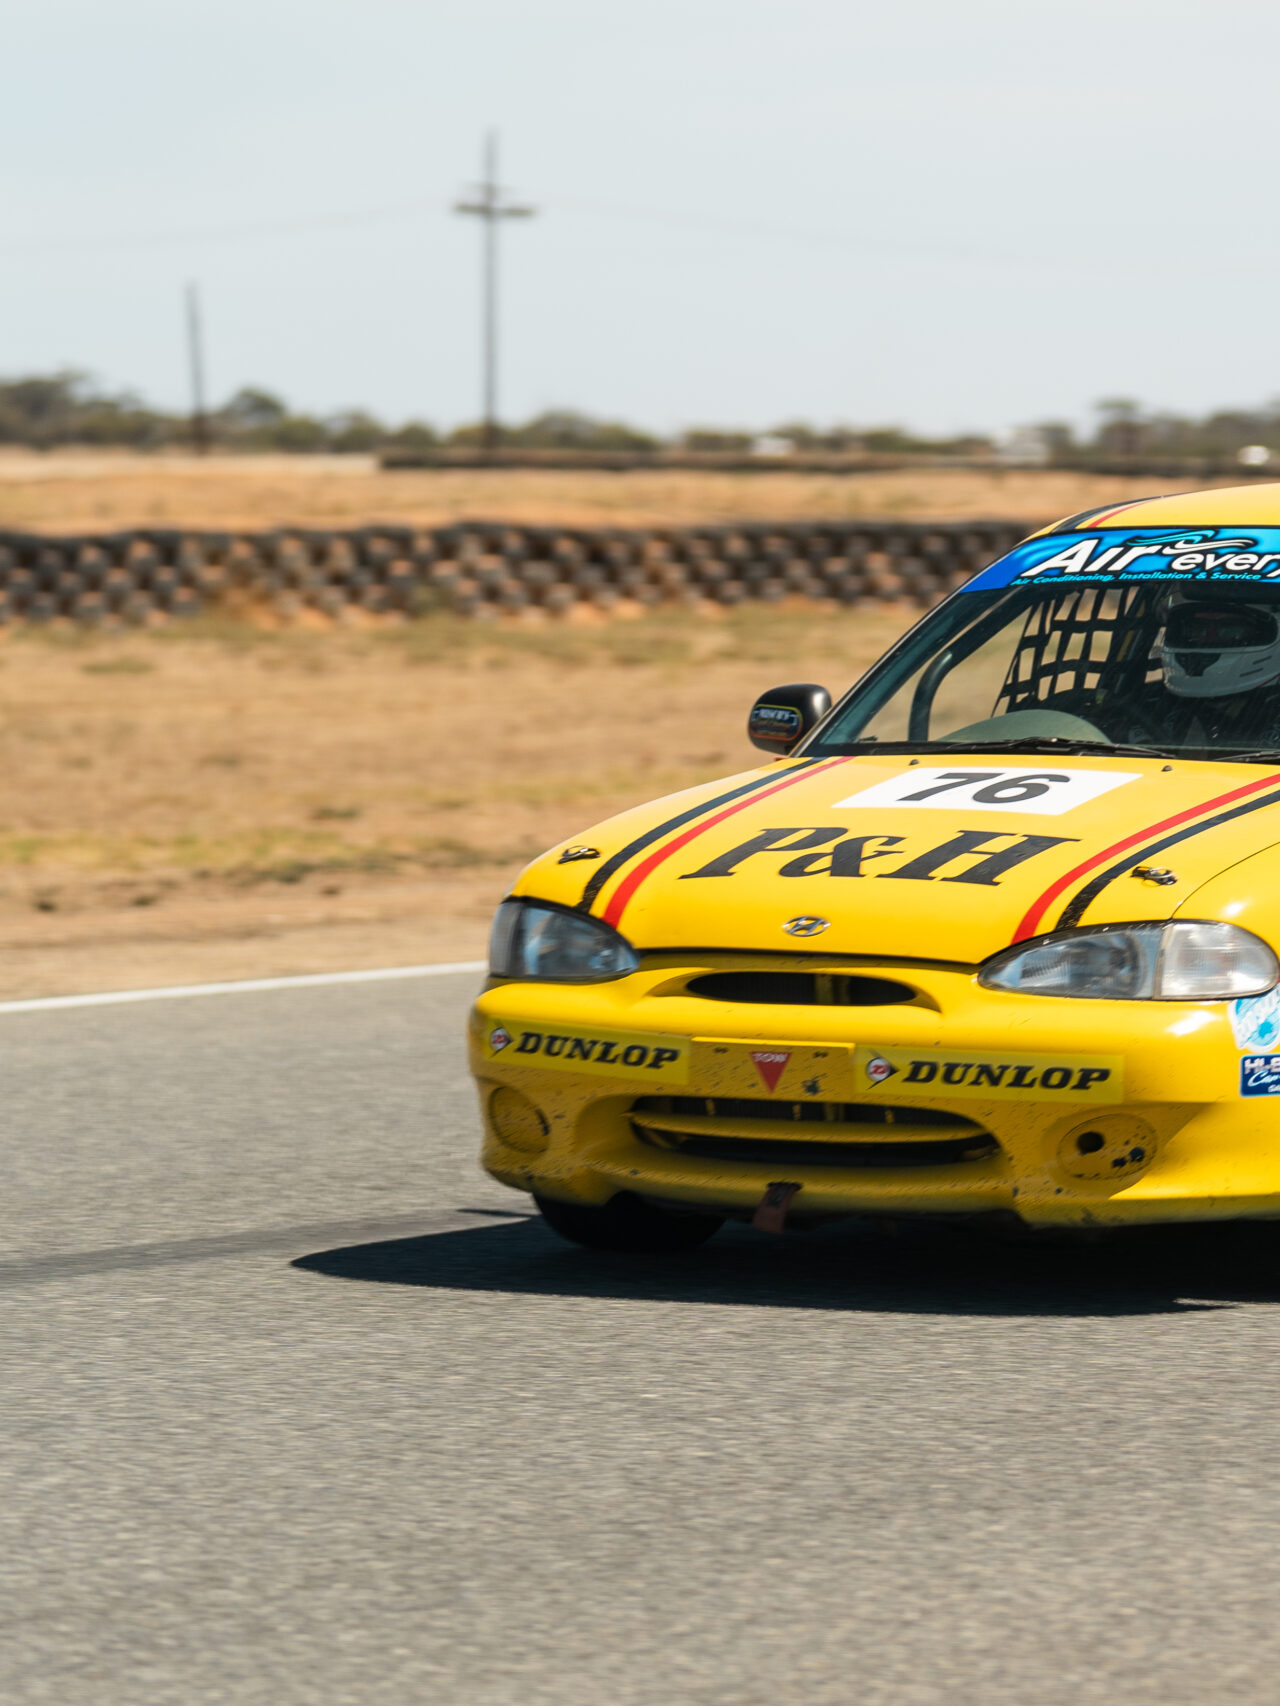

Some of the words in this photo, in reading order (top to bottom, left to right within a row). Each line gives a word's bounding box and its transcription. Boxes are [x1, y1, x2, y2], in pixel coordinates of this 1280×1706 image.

[1019, 538, 1164, 578] Air
[1010, 577, 1033, 586] Air
[1118, 571, 1193, 580] Installation
[1194, 572, 1207, 580] &
[1209, 571, 1262, 581] Service
[895, 772, 1071, 804] 76
[677, 826, 1083, 887] P&H
[514, 1031, 681, 1070] DUNLOP
[752, 1051, 787, 1064] TOW
[902, 1060, 1111, 1091] DUNLOP
[1247, 1070, 1280, 1087] Car
